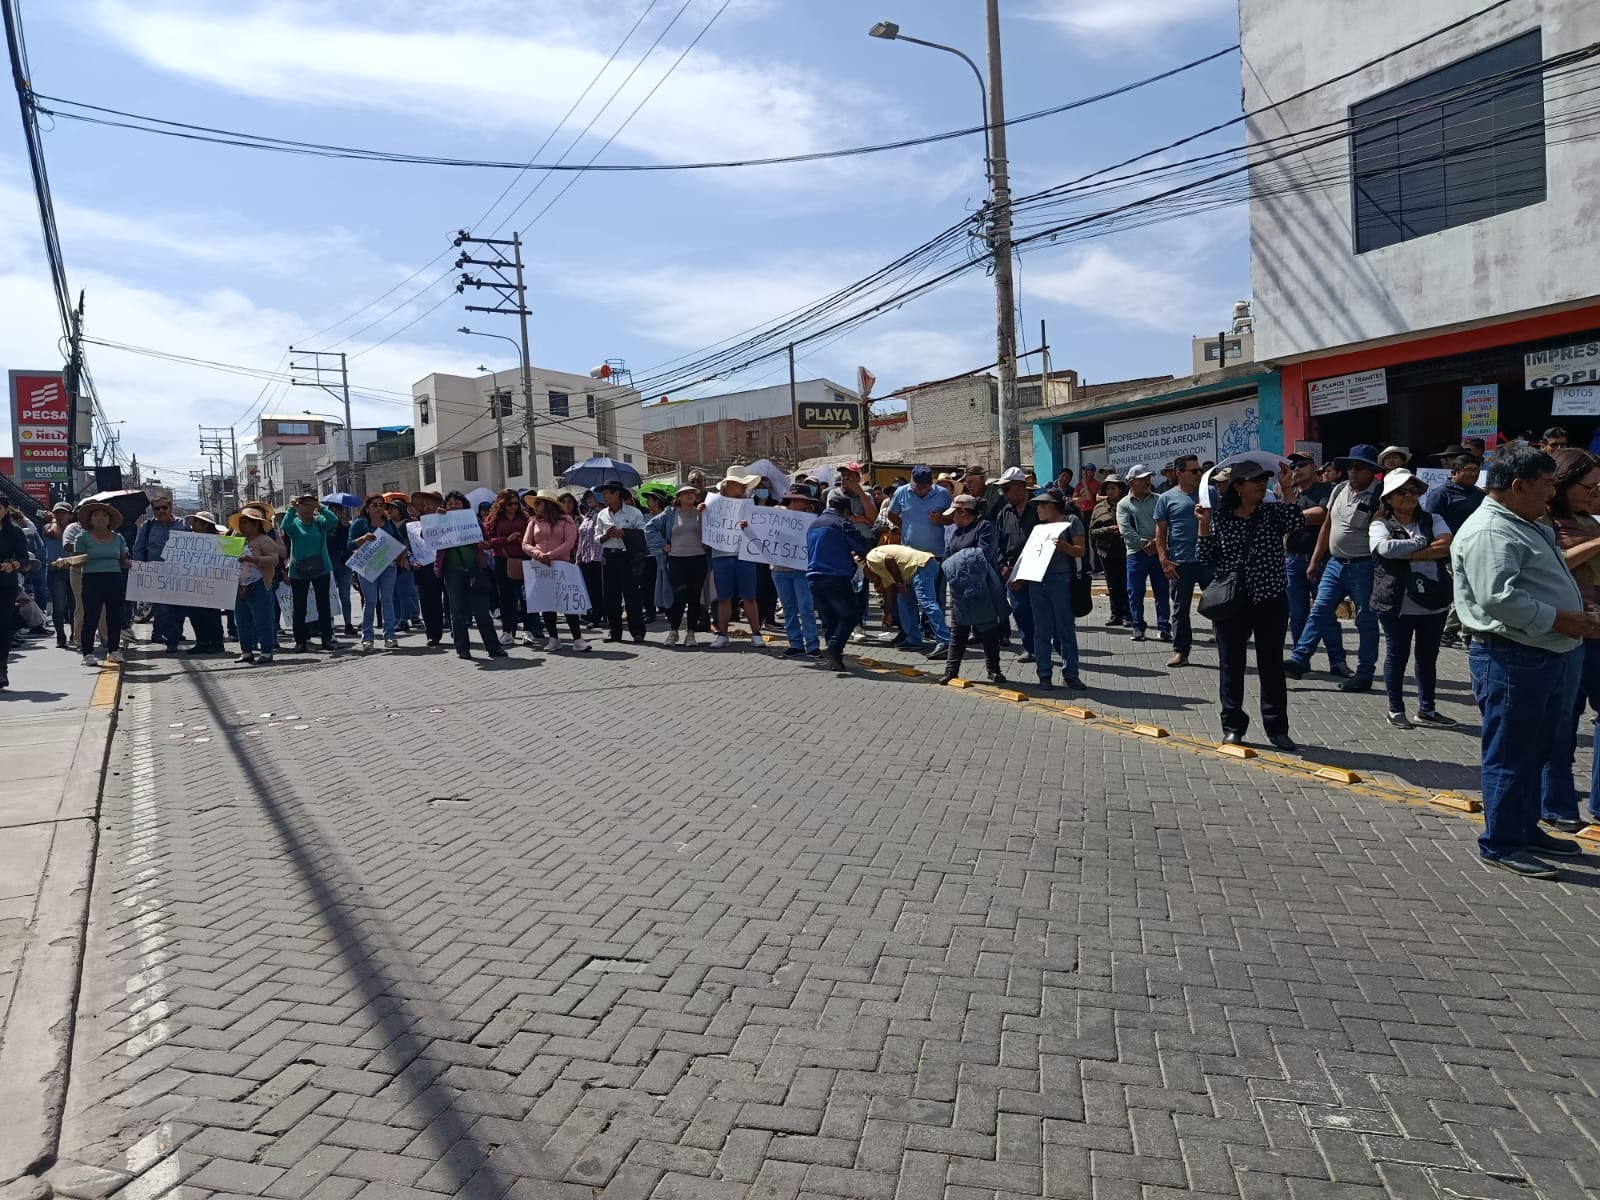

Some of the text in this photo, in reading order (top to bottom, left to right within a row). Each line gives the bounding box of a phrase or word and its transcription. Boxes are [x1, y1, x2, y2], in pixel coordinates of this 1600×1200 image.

[1526, 343, 1600, 366] IMPRES
[1321, 380, 1345, 389] PLANOS
[1530, 368, 1600, 389] COPI
[1563, 389, 1593, 397] FOTOS
[23, 410, 67, 420] PECSA
[805, 408, 852, 421] PLAYA
[1108, 419, 1214, 443] PROPIEDAD DE SOCIEDAD DE
[1108, 432, 1214, 454] BENEFICENCIA DE AREQUIPA:
[1112, 445, 1206, 465] INMUEBLE RECUPERADO CON
[704, 512, 742, 531] JUSTIC
[751, 512, 804, 531] ESTAMOS
[708, 530, 743, 546] IGUALDA
[768, 528, 780, 537] EN
[167, 536, 212, 552] SOMOS
[746, 538, 808, 560] CRISIS
[136, 573, 152, 588] NO
[531, 566, 566, 581] TARIFA
